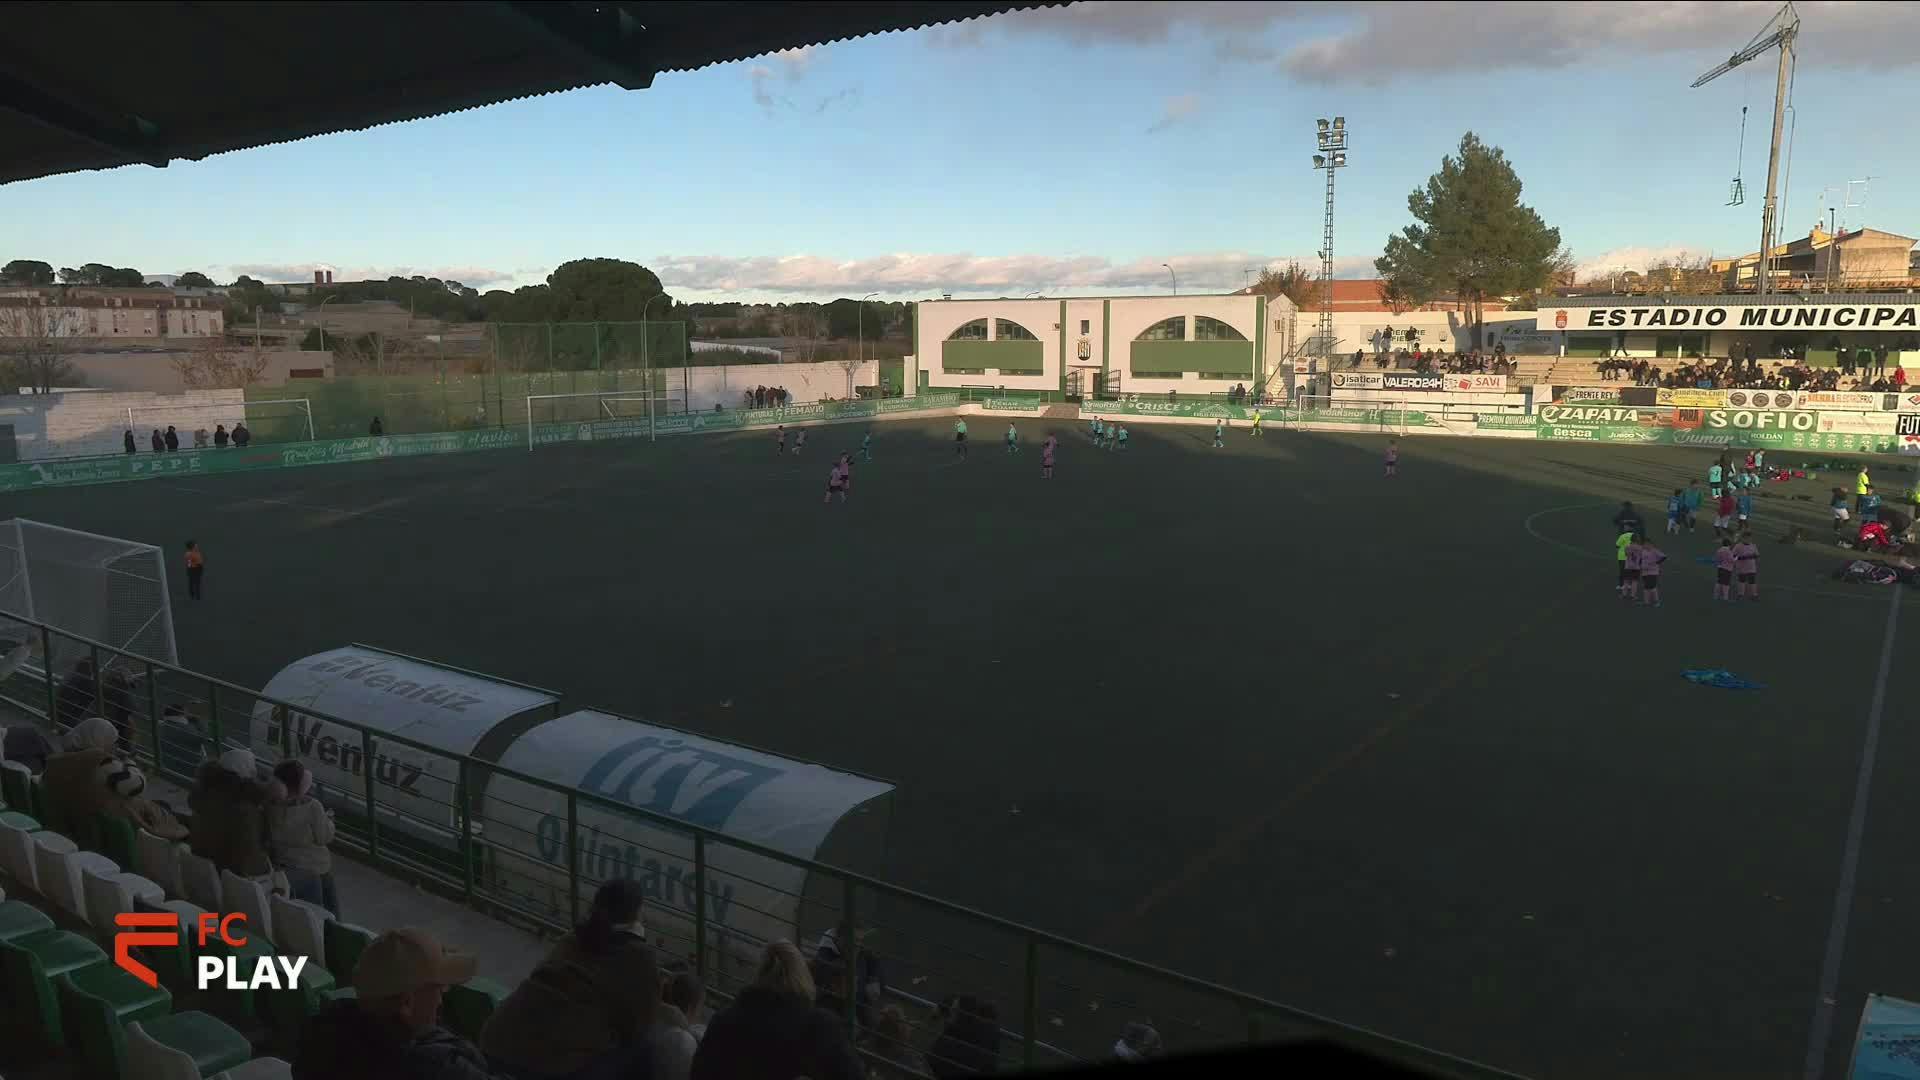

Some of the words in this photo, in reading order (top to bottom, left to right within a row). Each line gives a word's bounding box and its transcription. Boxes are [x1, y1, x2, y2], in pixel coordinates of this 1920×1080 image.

[1587, 308, 1728, 327] ESTADIO
[1739, 307, 1917, 327] MUNICIPA
[1345, 375, 1381, 384] isaticar
[1475, 377, 1500, 387] SAVI
[1575, 389, 1600, 400] FRENTE
[1601, 390, 1615, 399] REY
[1558, 407, 1639, 422] ZAPATA
[1709, 410, 1814, 430] SOFIO
[1553, 428, 1592, 437] Gesca
[1751, 432, 1783, 440] ROLDÁN
[130, 456, 201, 473] PEPE
